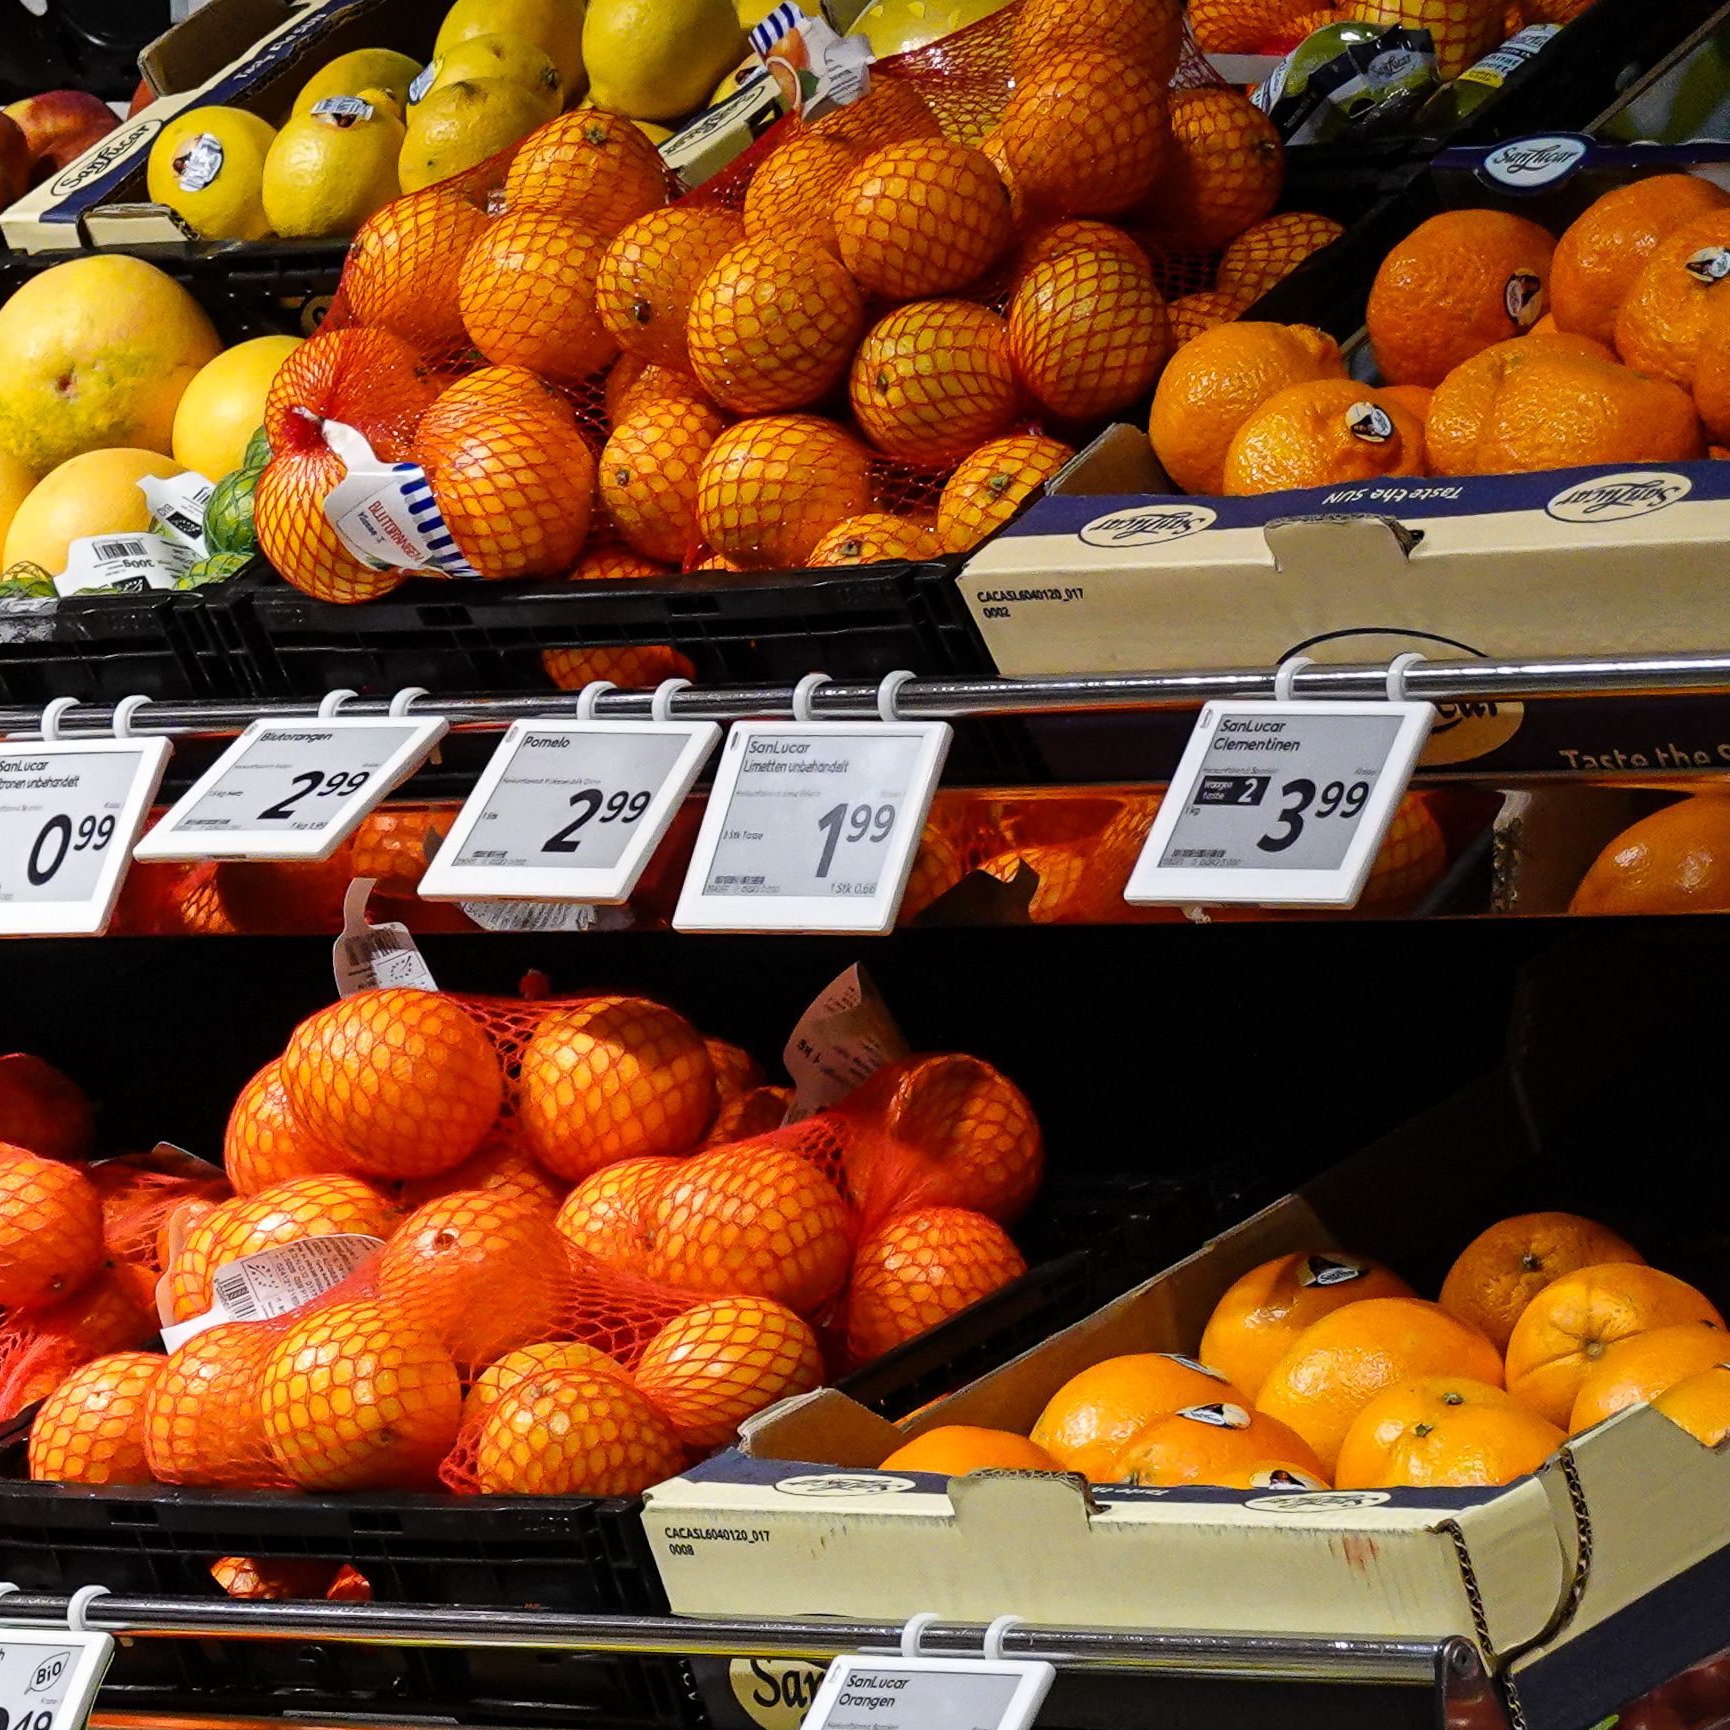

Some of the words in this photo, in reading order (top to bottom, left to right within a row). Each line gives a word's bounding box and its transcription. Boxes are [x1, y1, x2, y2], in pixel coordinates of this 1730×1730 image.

[58, 123, 150, 189] SanLucar
[1492, 144, 1581, 174] SanLucar
[1322, 489, 1368, 504] SUN
[1370, 487, 1409, 502] the
[1411, 484, 1463, 501] Taste
[1553, 477, 1685, 519] SanLucar
[367, 499, 425, 563] BLUTORANGEN
[1218, 718, 1287, 735] SanLucar
[259, 730, 334, 743] Blutorangen
[523, 735, 571, 750] Pomelo
[1213, 736, 1302, 754] Clementinen
[748, 739, 812, 756] SanLucar
[742, 759, 786, 775] Limetten
[787, 759, 851, 775] unbehandelt
[1241, 779, 1258, 803] 2
[665, 1527, 771, 1545] CACASL6040120_017
[35, 1659, 64, 1687] BiO
[846, 1673, 910, 1691] SanLucar
[837, 1693, 896, 1711] Orangen
